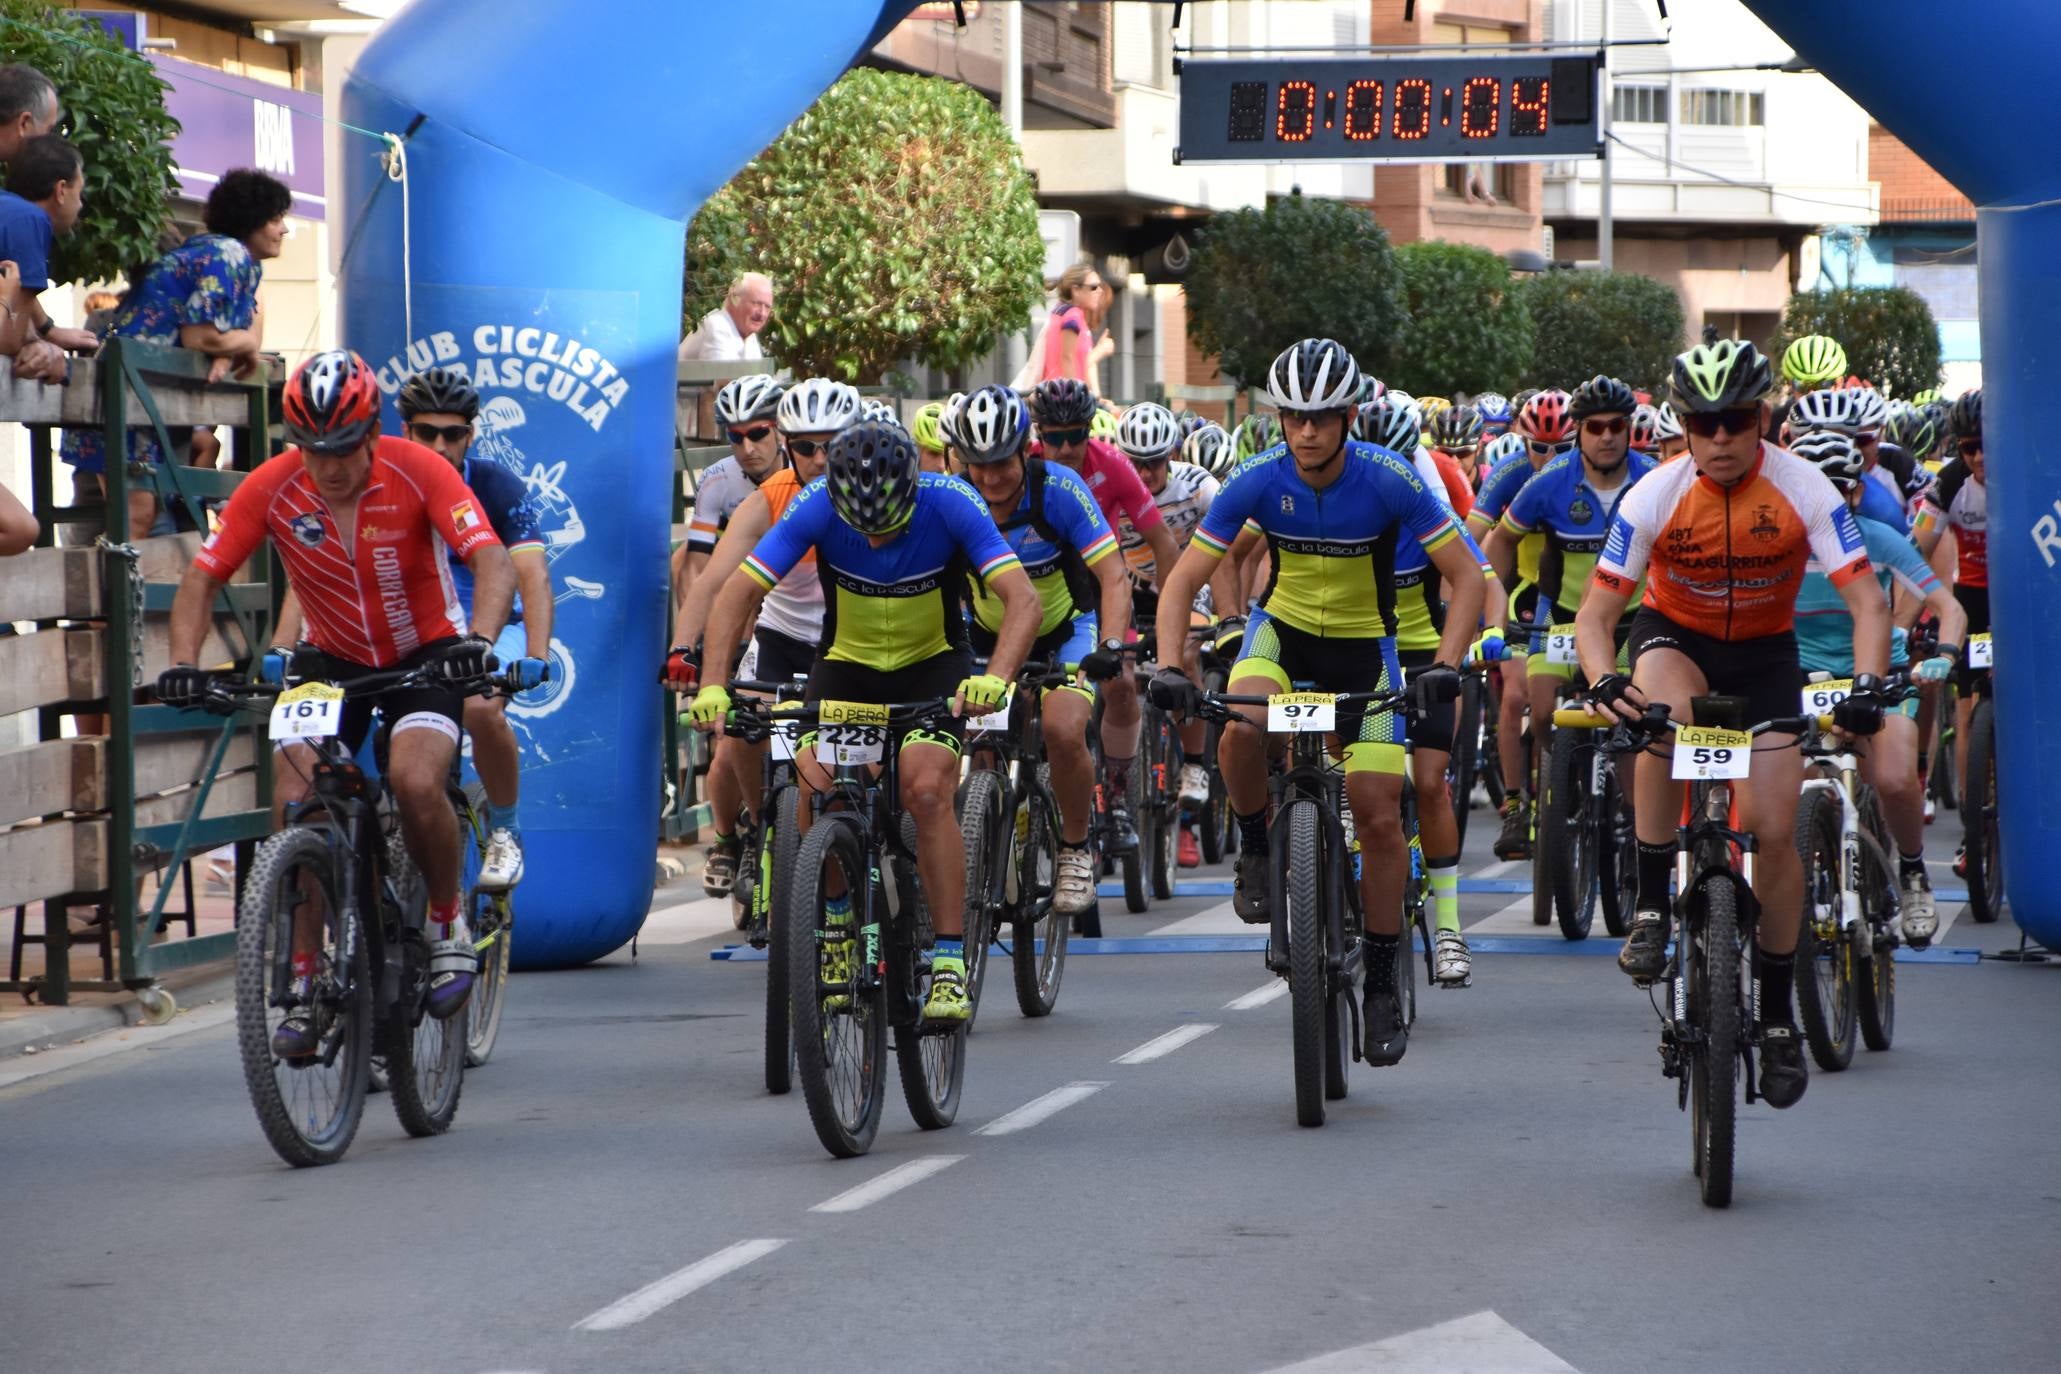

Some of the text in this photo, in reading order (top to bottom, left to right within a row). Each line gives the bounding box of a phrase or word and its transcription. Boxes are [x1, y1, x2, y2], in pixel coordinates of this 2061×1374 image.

[1276, 77, 1549, 141] 0:00:04
[254, 97, 295, 176] BBVA
[376, 325, 629, 408] CLUB CICLISTA
[1382, 454, 1424, 494] bascula
[2031, 499, 2061, 568] R
[1317, 544, 1370, 555] bascula
[877, 579, 936, 595] bascula
[1813, 691, 1846, 707] 60
[281, 700, 328, 719] 161
[823, 707, 887, 725] LA PERA
[1284, 705, 1320, 718] 97
[825, 727, 881, 746] 228
[1680, 733, 1700, 743] LA
[1706, 734, 1748, 746] PERA
[1692, 748, 1732, 764] 59
